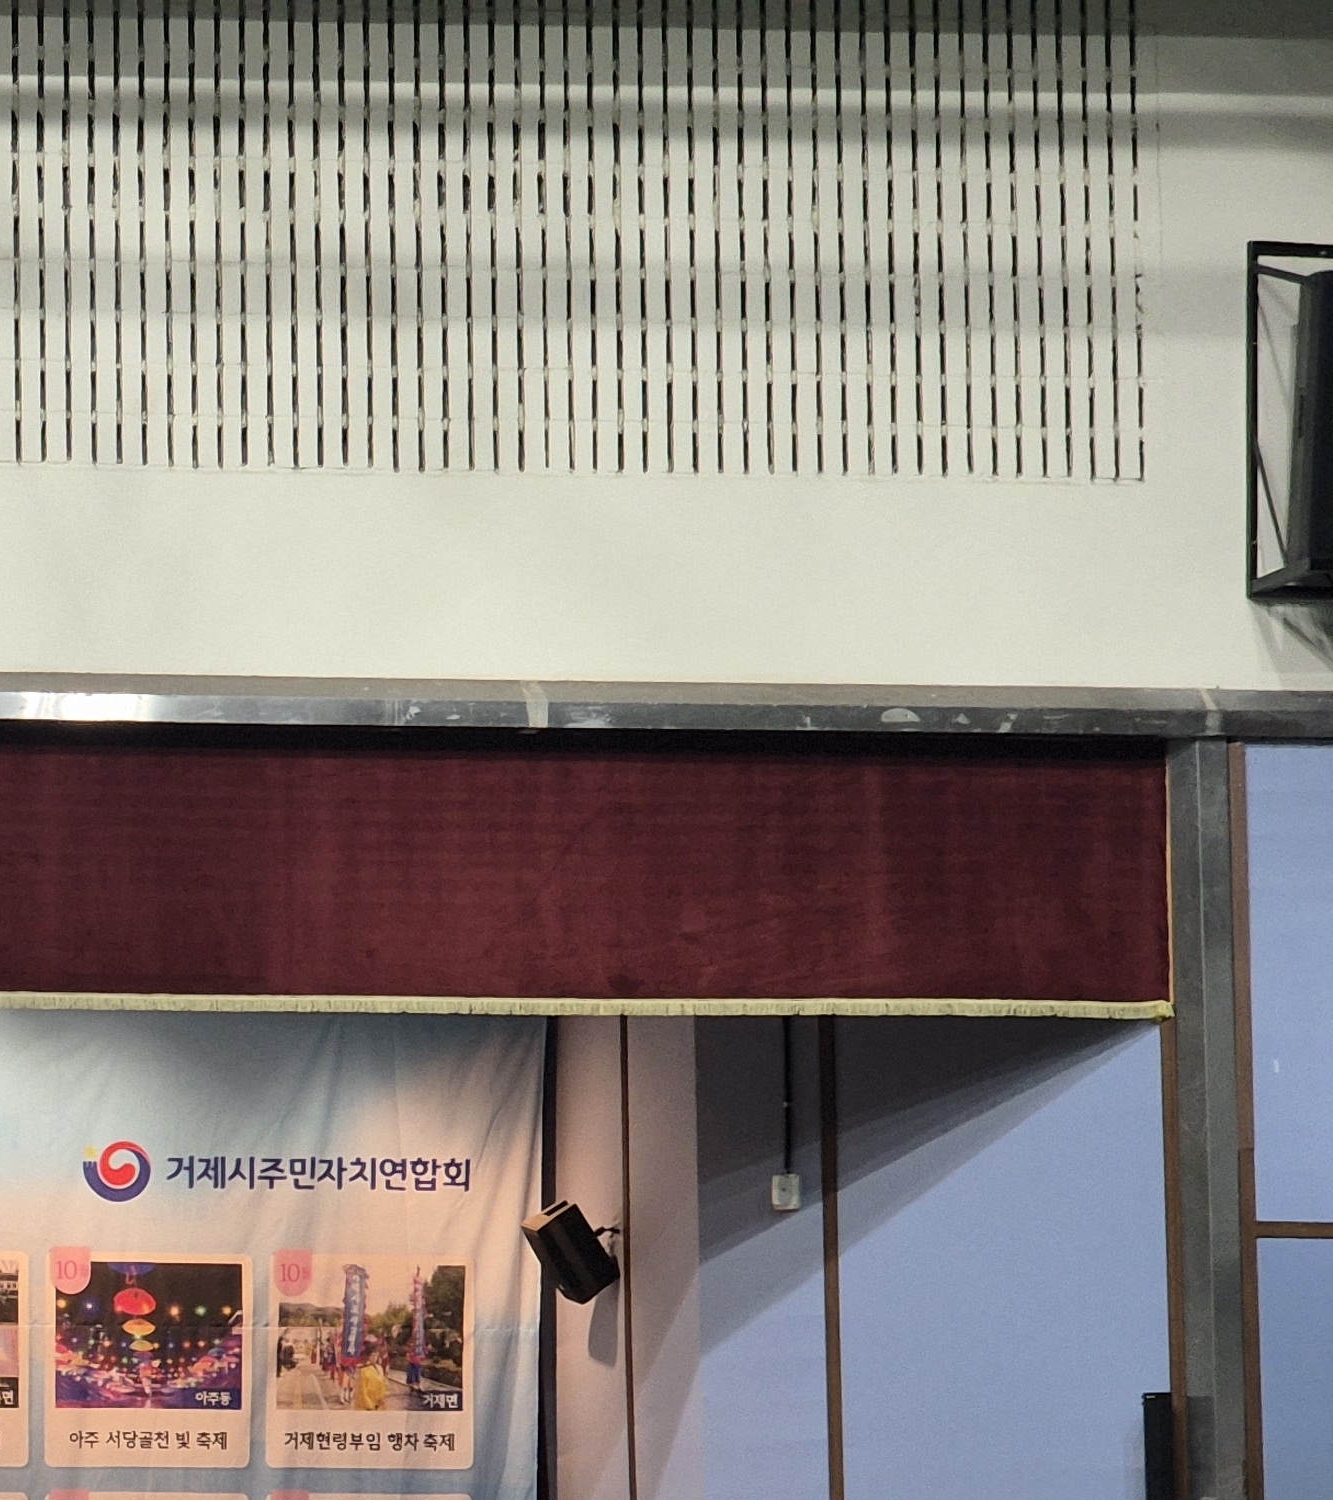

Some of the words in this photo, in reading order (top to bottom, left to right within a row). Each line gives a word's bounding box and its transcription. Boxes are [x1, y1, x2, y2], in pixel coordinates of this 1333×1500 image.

[166, 1156, 470, 1192] 거제시주민자치연합회
[69, 1430, 99, 1449] 아주
[106, 1430, 169, 1449] 서당골천
[175, 1431, 190, 1449] 빛
[196, 1431, 228, 1450] 축제
[284, 1431, 381, 1451] 거제현령부임
[387, 1432, 419, 1451] 행차
[423, 1432, 455, 1451] 축제
